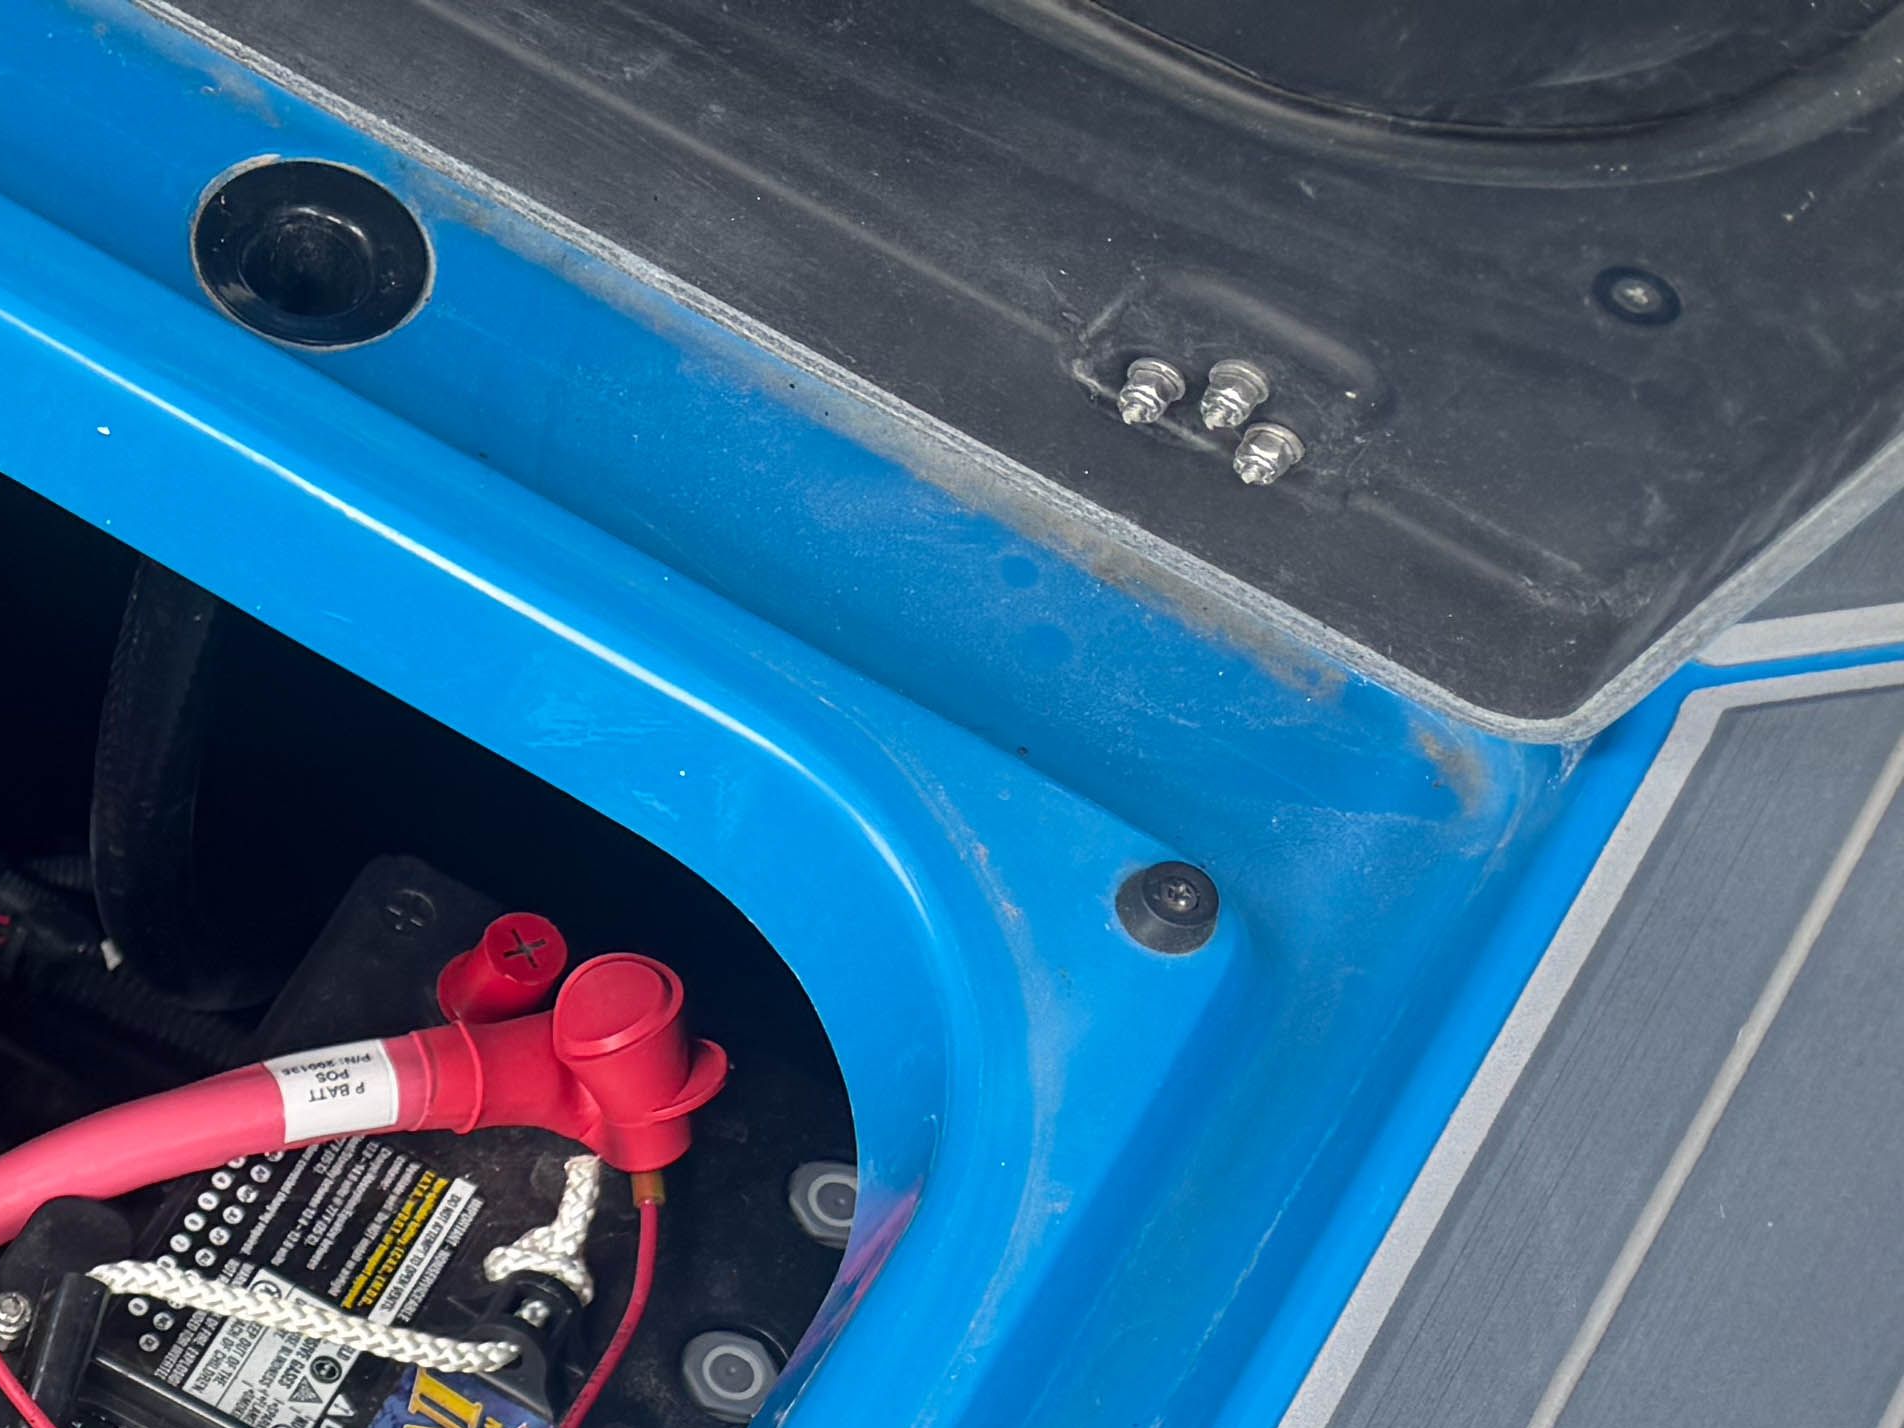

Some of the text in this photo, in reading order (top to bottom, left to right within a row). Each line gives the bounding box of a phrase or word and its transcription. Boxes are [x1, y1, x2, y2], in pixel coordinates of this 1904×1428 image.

[315, 1068, 350, 1083] POS
[309, 1081, 365, 1102] P BATT
[218, 1335, 235, 1352] OF
[212, 1336, 253, 1389] OUT OF THE
[276, 1357, 305, 1390] GASES
